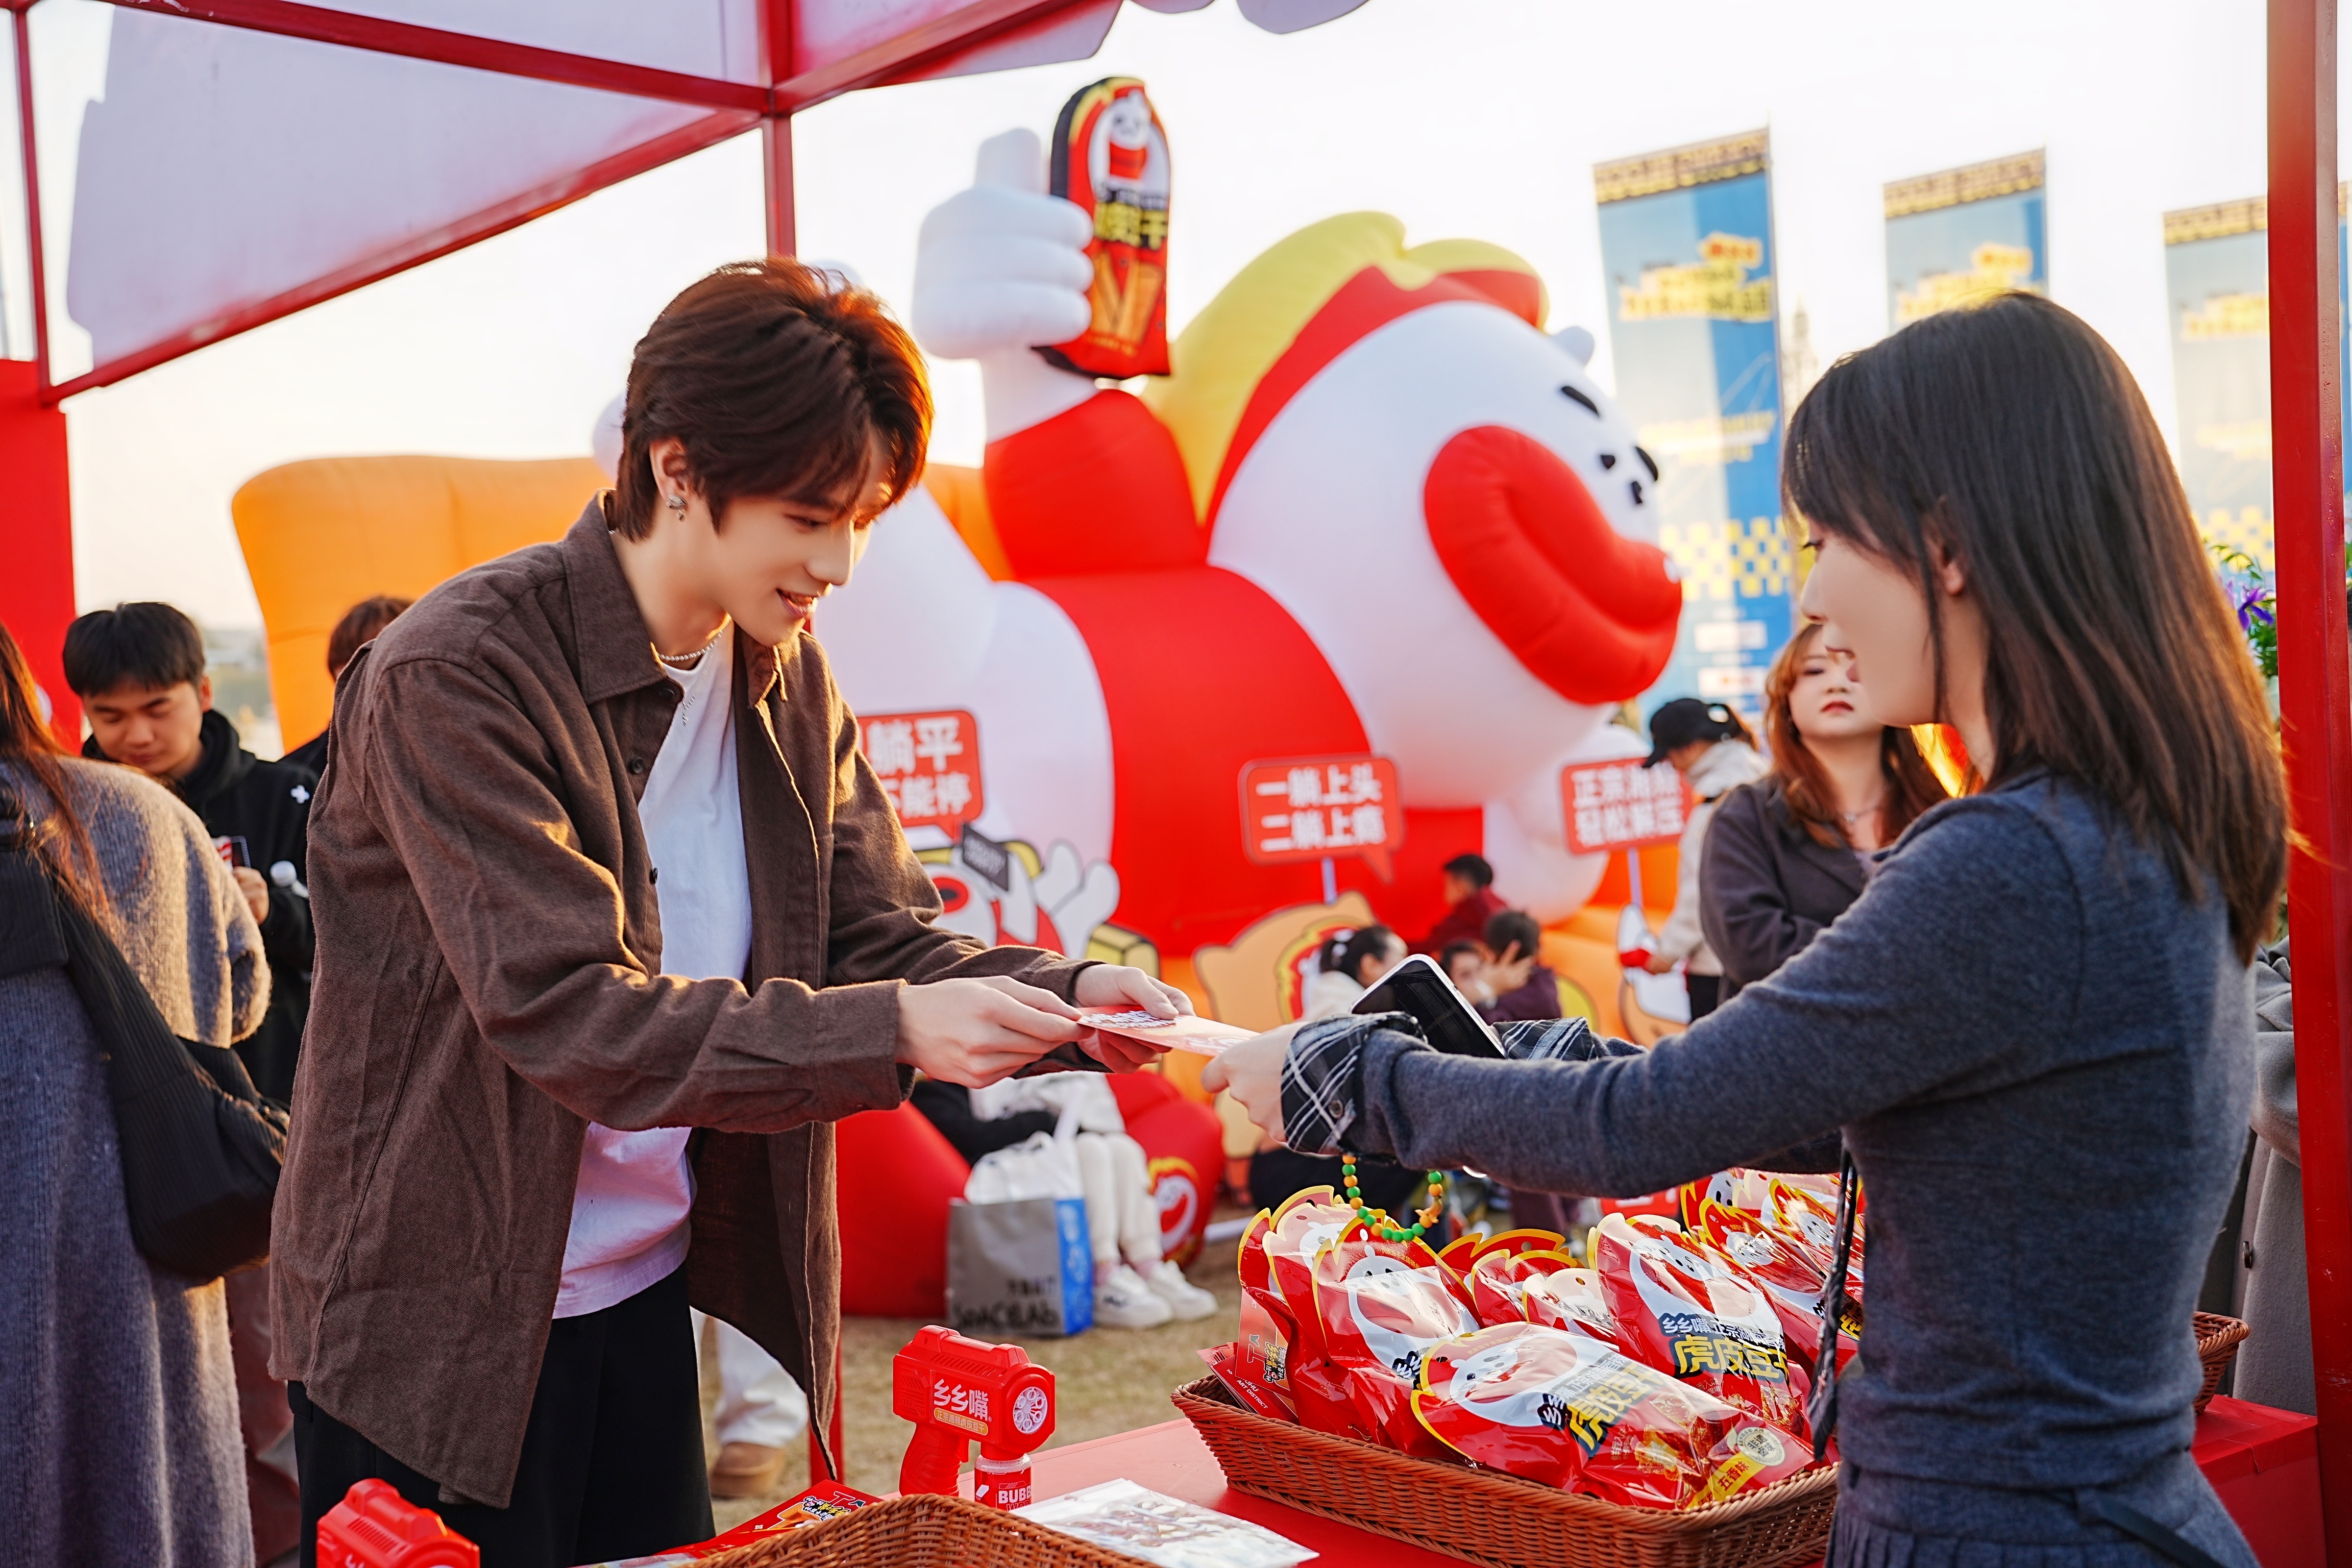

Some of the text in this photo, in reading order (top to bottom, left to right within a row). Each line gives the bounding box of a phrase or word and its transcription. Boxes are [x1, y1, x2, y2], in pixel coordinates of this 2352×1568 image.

[859, 716, 964, 776] 躺平
[1256, 763, 1382, 807] 一躺上头
[1662, 1317, 1710, 1333] 乡乡嘴
[934, 1378, 989, 1422] 乡乡嘴
[1236, 1380, 1268, 1409] ART DISTRICT
[1543, 1386, 1578, 1426] 乡乡嘴
[1566, 1363, 1664, 1451] 虎皮豆干
[1747, 1434, 1768, 1449] 非遗
[1758, 1442, 1776, 1457] 卤味
[1718, 1461, 1749, 1491] 五香味
